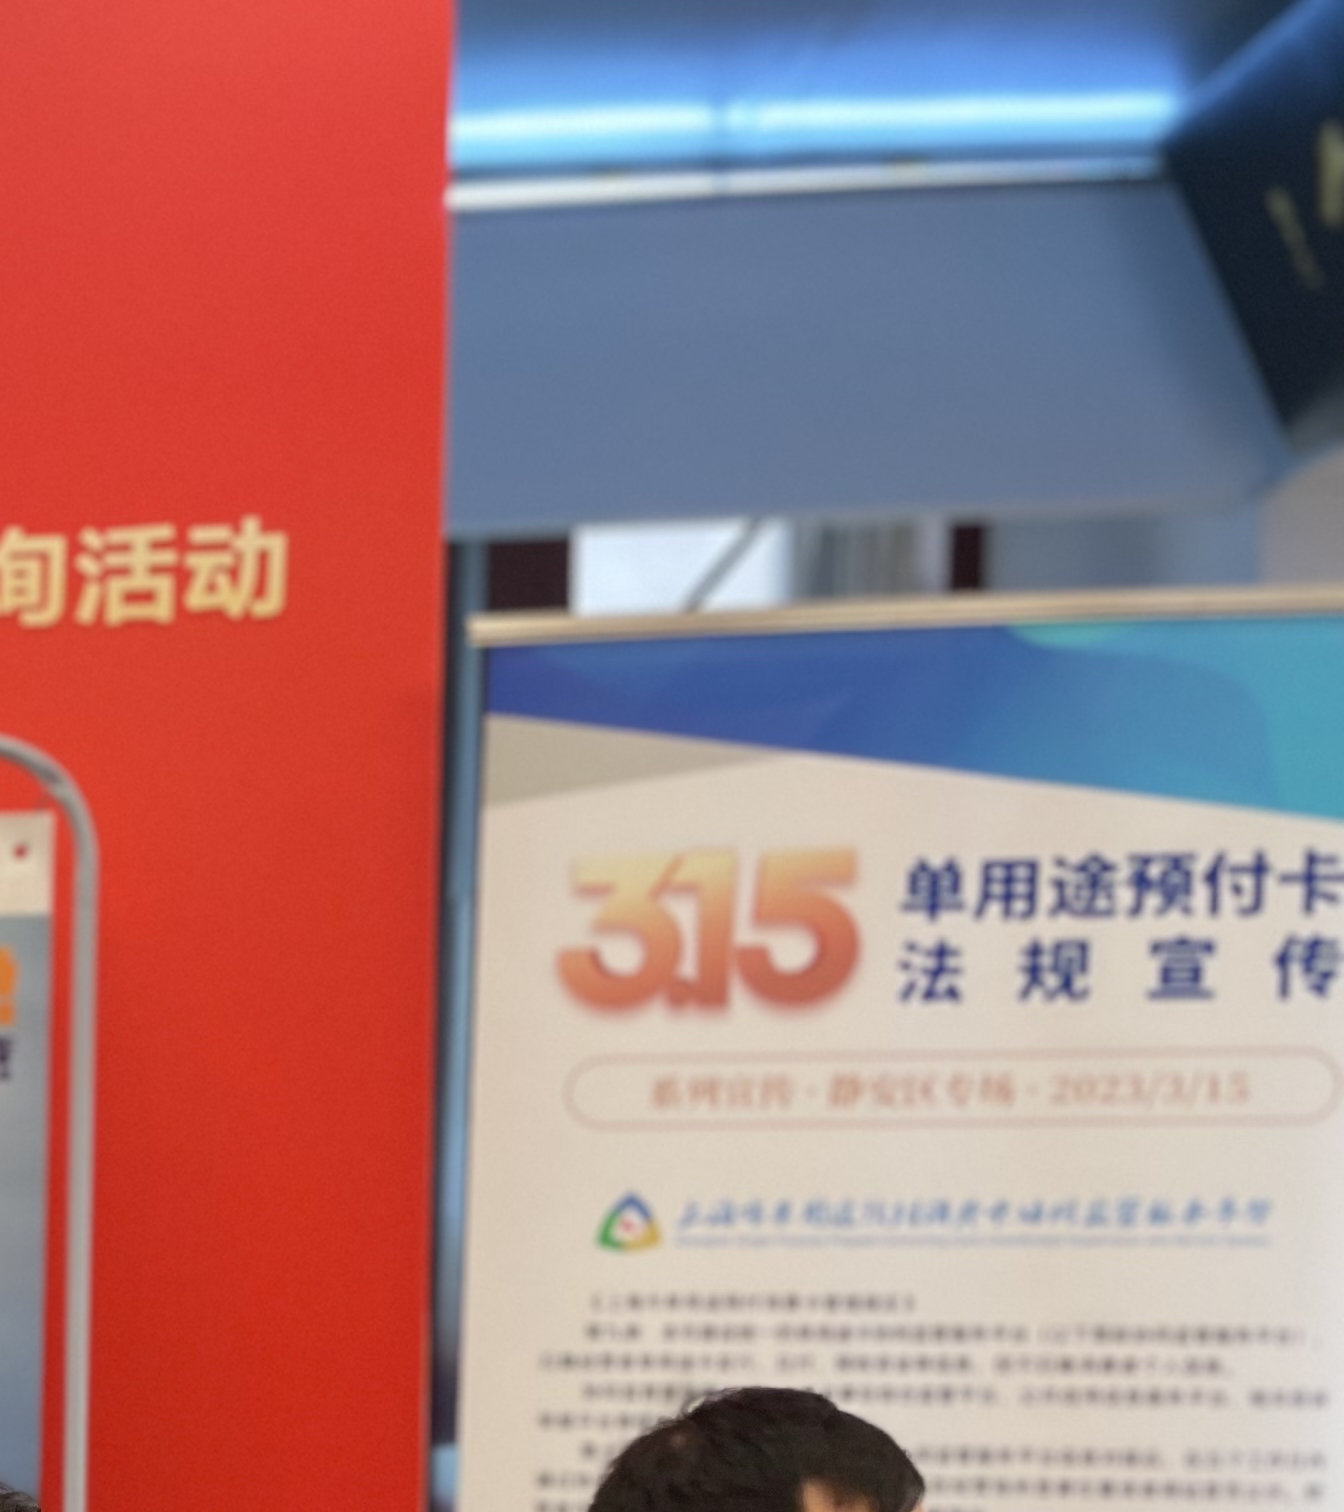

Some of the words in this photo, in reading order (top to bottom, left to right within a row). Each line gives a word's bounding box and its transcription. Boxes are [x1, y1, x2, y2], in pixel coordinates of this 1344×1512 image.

[900, 851, 1344, 922] 单用途预付卡
[900, 938, 1342, 1004] 法规宣传
